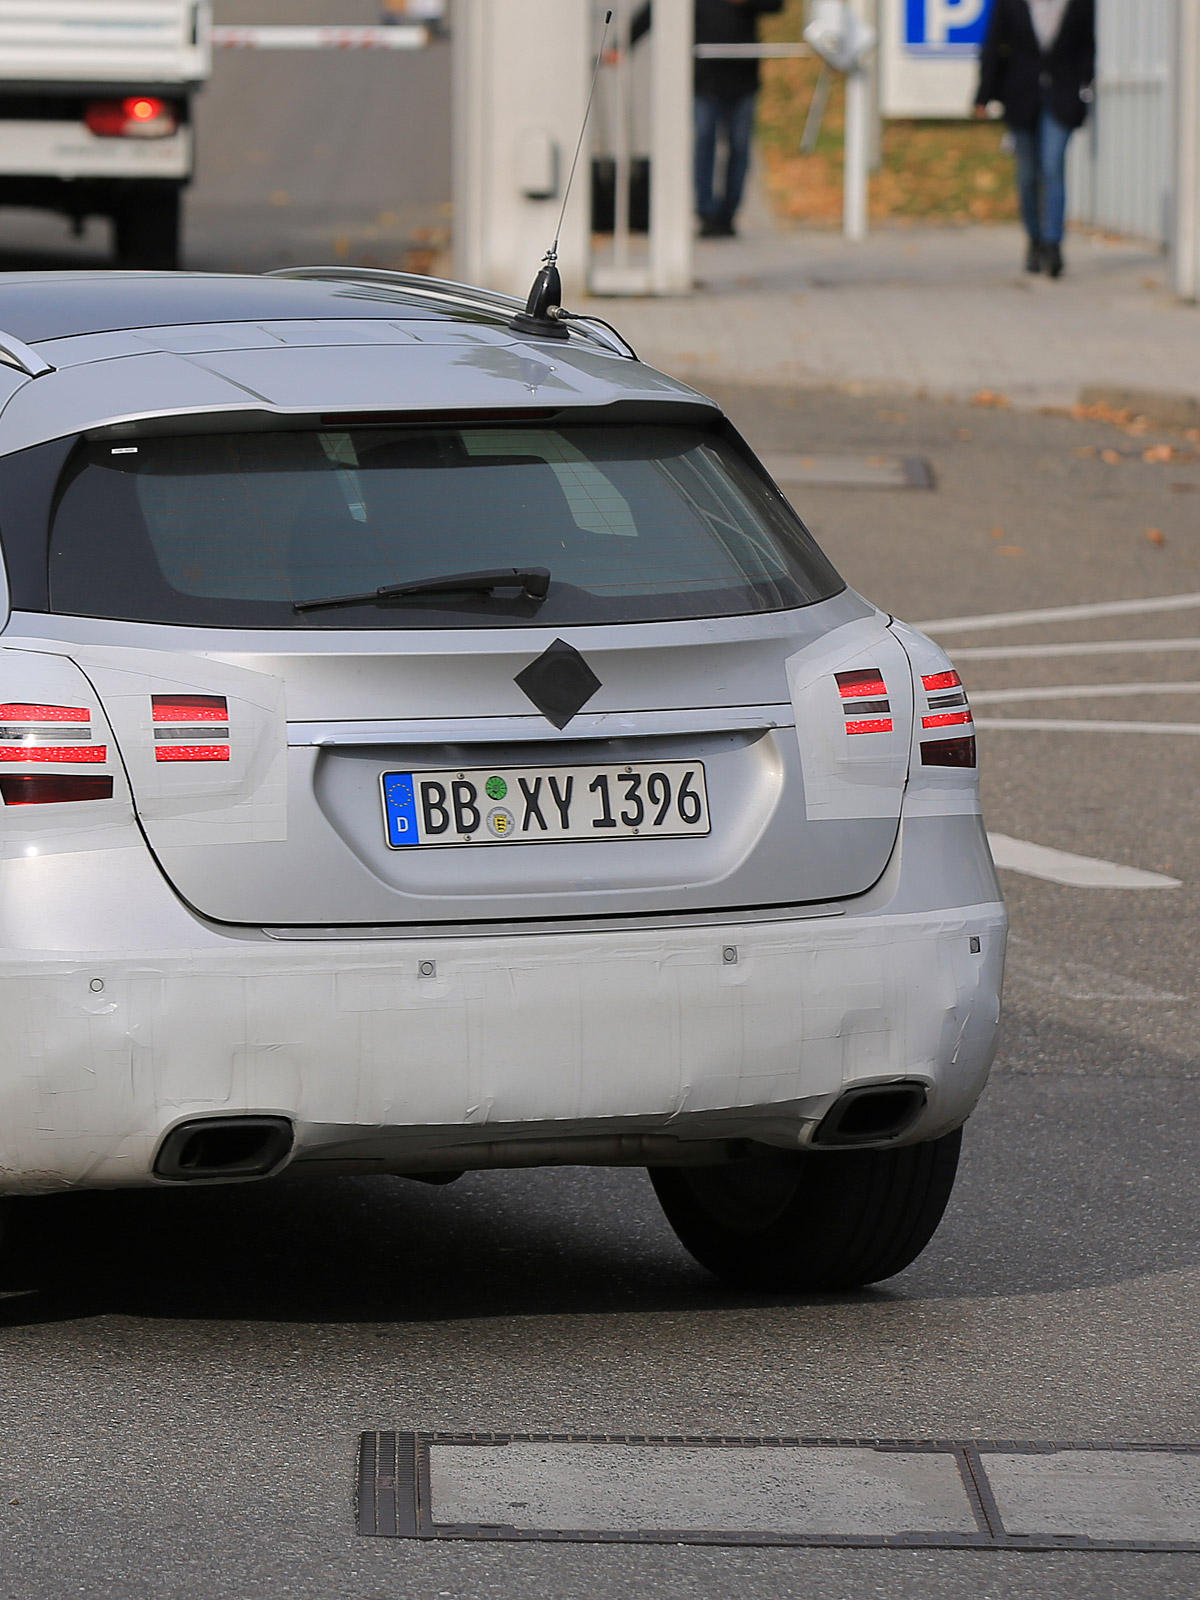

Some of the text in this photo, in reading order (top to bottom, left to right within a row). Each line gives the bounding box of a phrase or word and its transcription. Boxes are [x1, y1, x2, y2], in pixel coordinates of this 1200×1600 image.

[924, 0, 985, 47] P
[397, 816, 409, 832] D
[420, 780, 480, 835] BB
[517, 776, 573, 831] XY
[589, 772, 701, 828] 1396
